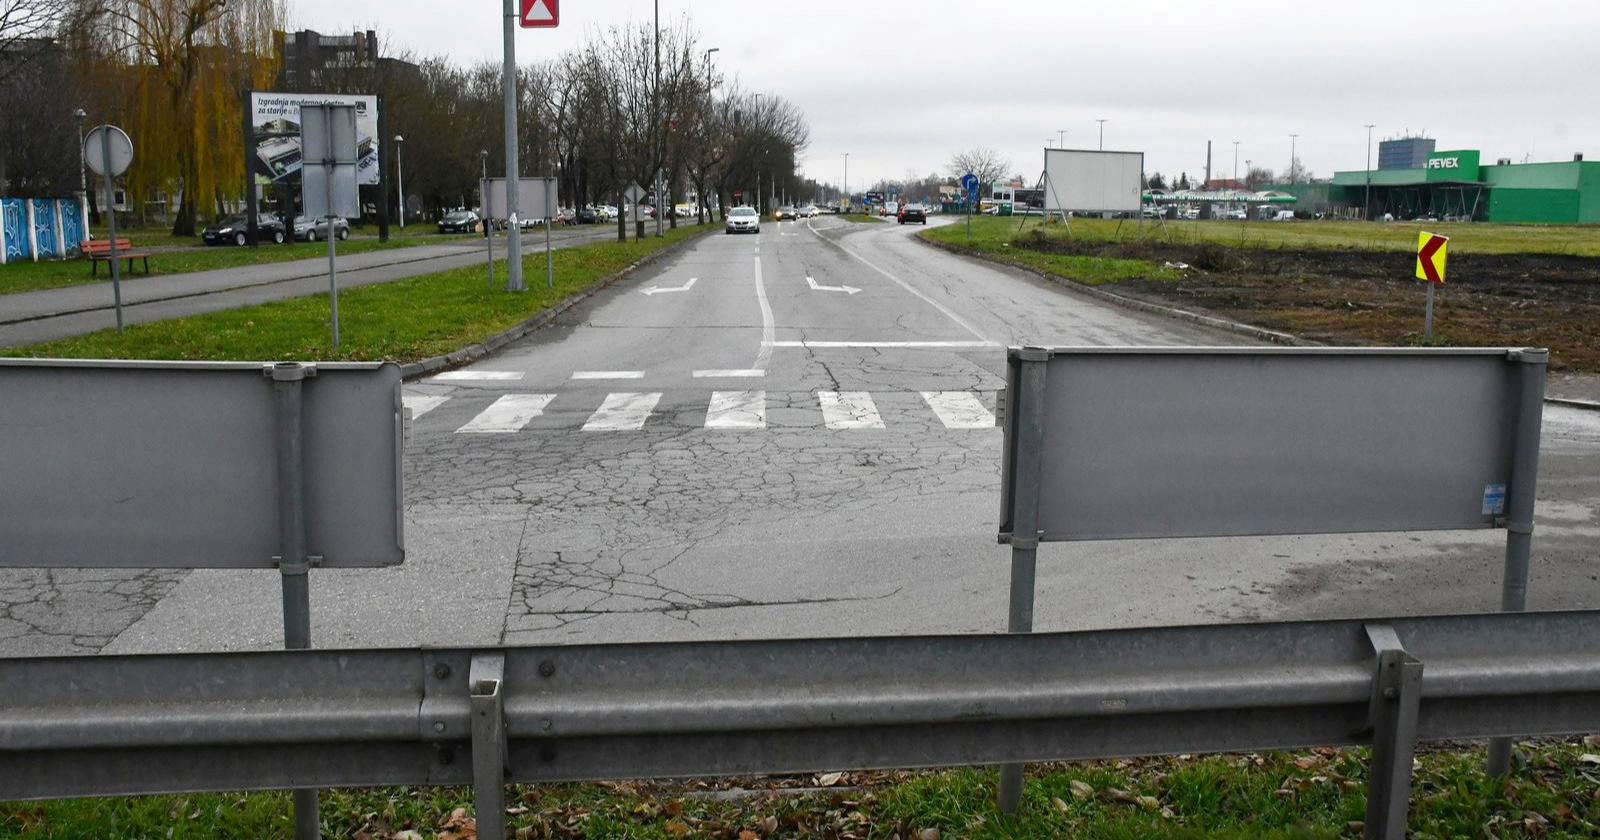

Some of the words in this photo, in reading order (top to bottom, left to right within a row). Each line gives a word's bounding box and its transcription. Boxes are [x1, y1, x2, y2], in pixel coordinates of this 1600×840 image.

[258, 98, 290, 107] Izgradnja
[267, 107, 287, 116] starije
[1428, 157, 1459, 169] PEVEX
